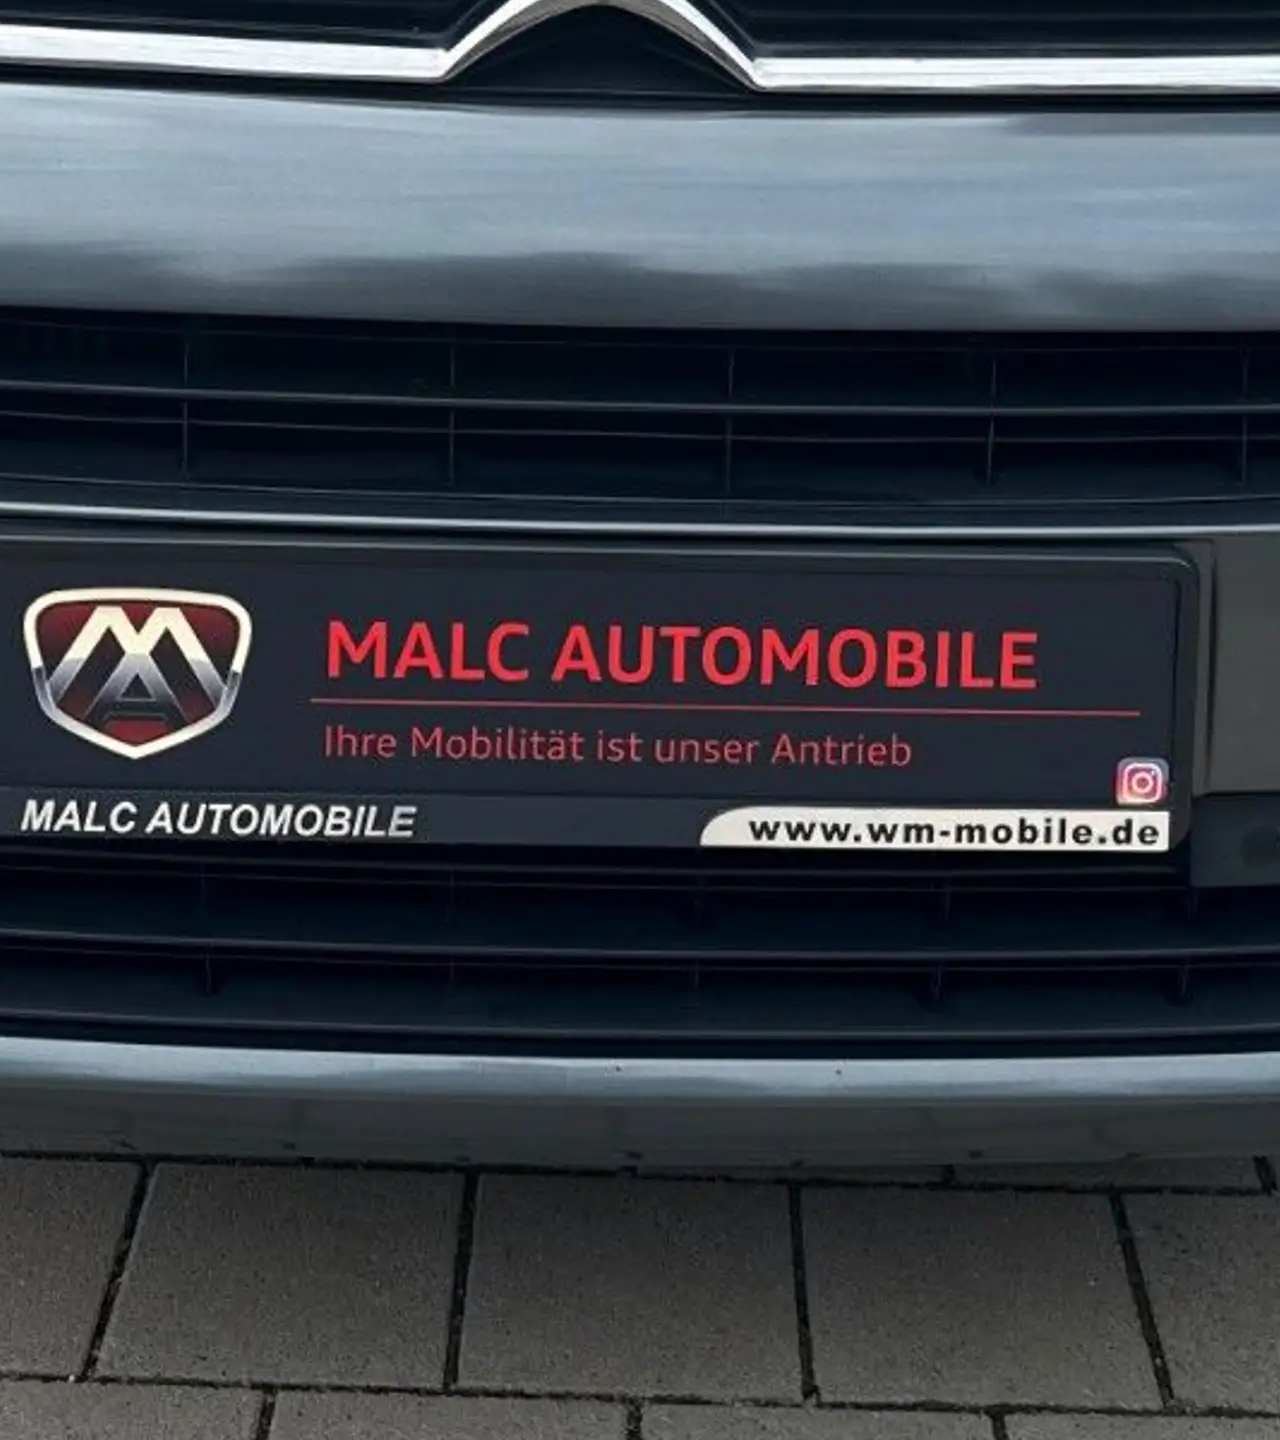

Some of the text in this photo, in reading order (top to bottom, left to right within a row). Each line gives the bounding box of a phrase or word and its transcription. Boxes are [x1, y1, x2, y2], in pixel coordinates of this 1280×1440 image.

[326, 621, 1038, 689] MALC AUTOMOBILE
[324, 724, 913, 768] Ihre Mobilität ist unser Antrieb
[20, 799, 418, 838] MALC AUTOMOBILE
[748, 816, 1161, 846] www.wm-mobile.de
